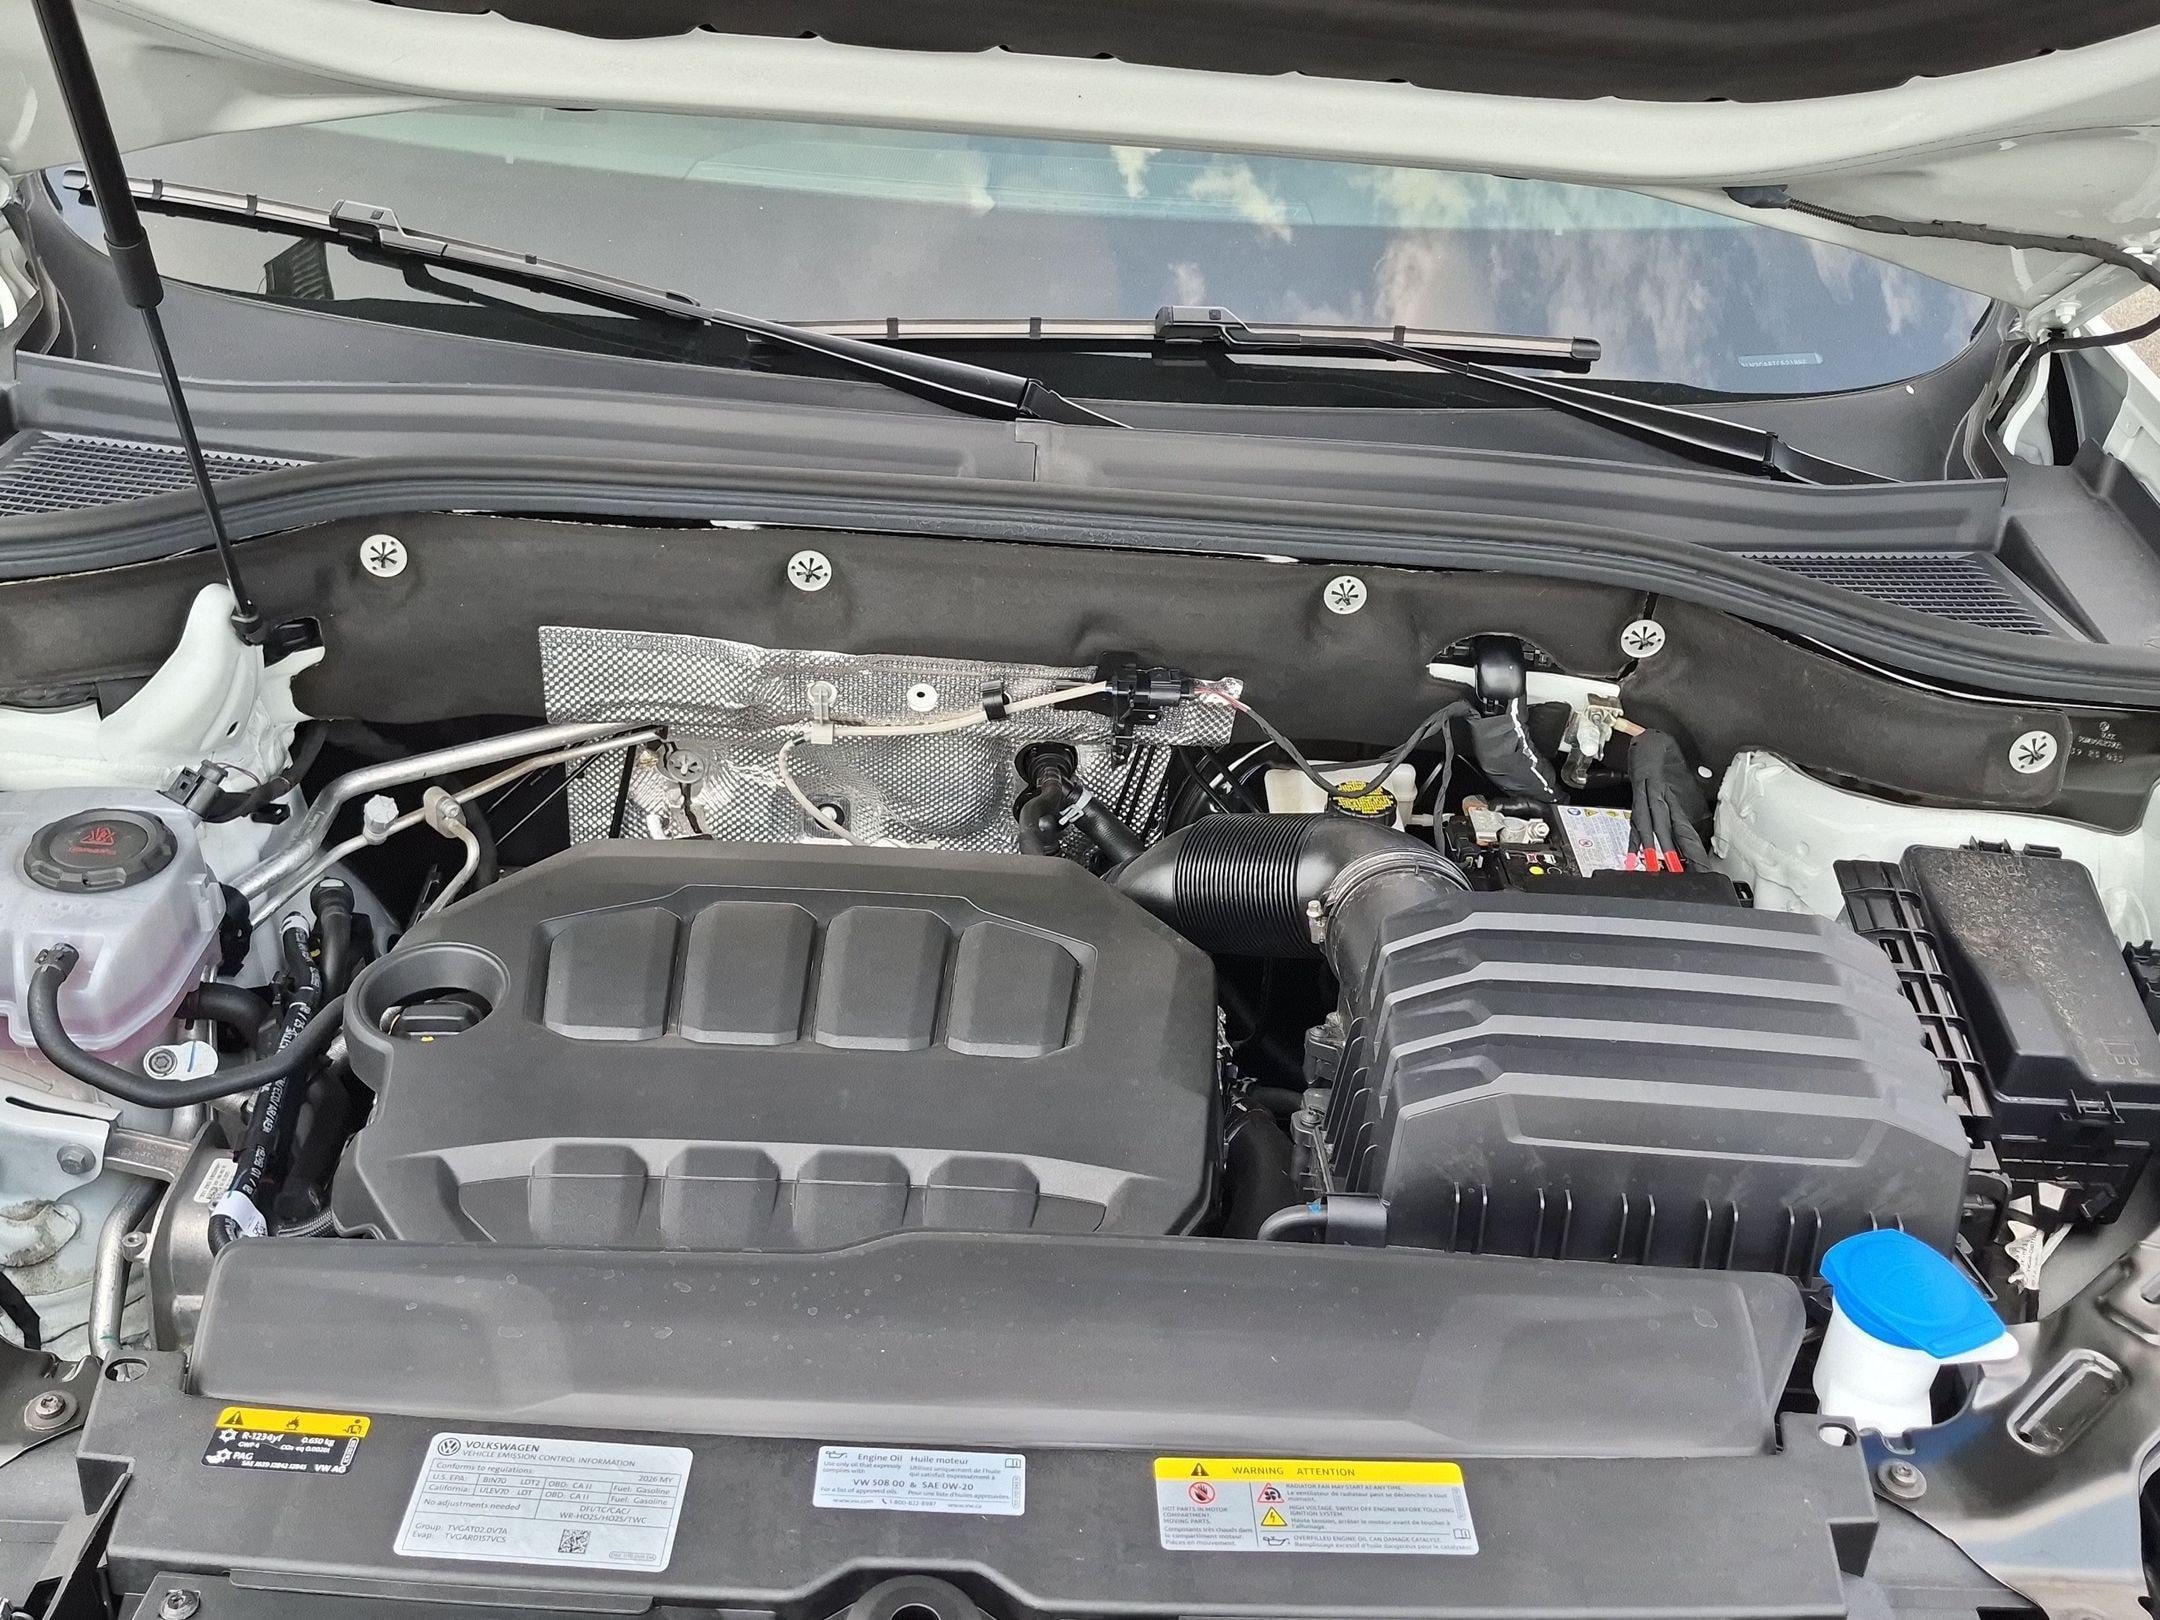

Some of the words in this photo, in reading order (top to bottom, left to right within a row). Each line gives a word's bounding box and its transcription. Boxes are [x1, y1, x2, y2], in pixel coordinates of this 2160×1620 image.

[466, 1440, 540, 1452] VOLKSWAGEN
[232, 1451, 254, 1461] PAG
[463, 1450, 495, 1458] VEHICLE
[497, 1452, 537, 1461] EMISSION
[538, 1455, 576, 1464] CONTROL
[578, 1457, 636, 1468] INFORMATION
[858, 1453, 888, 1462] Engine
[889, 1454, 903, 1462] Oil
[910, 1455, 935, 1464] Huile
[936, 1457, 969, 1465] moteur
[314, 1464, 332, 1472] VW
[330, 1465, 346, 1474] AG
[436, 1462, 475, 1471] Conforms
[1232, 1466, 1284, 1475] WARNING
[1297, 1467, 1355, 1477] ATTENTION
[638, 1475, 658, 1483] 2026
[853, 1479, 871, 1487] VW
[892, 1480, 905, 1488] 00
[942, 1482, 974, 1491] 0W-20
[635, 1486, 671, 1495] Gasoline
[423, 1498, 435, 1506] No
[436, 1500, 488, 1509] adjustments
[488, 1503, 521, 1511] needed
[633, 1496, 669, 1506] Gasoline
